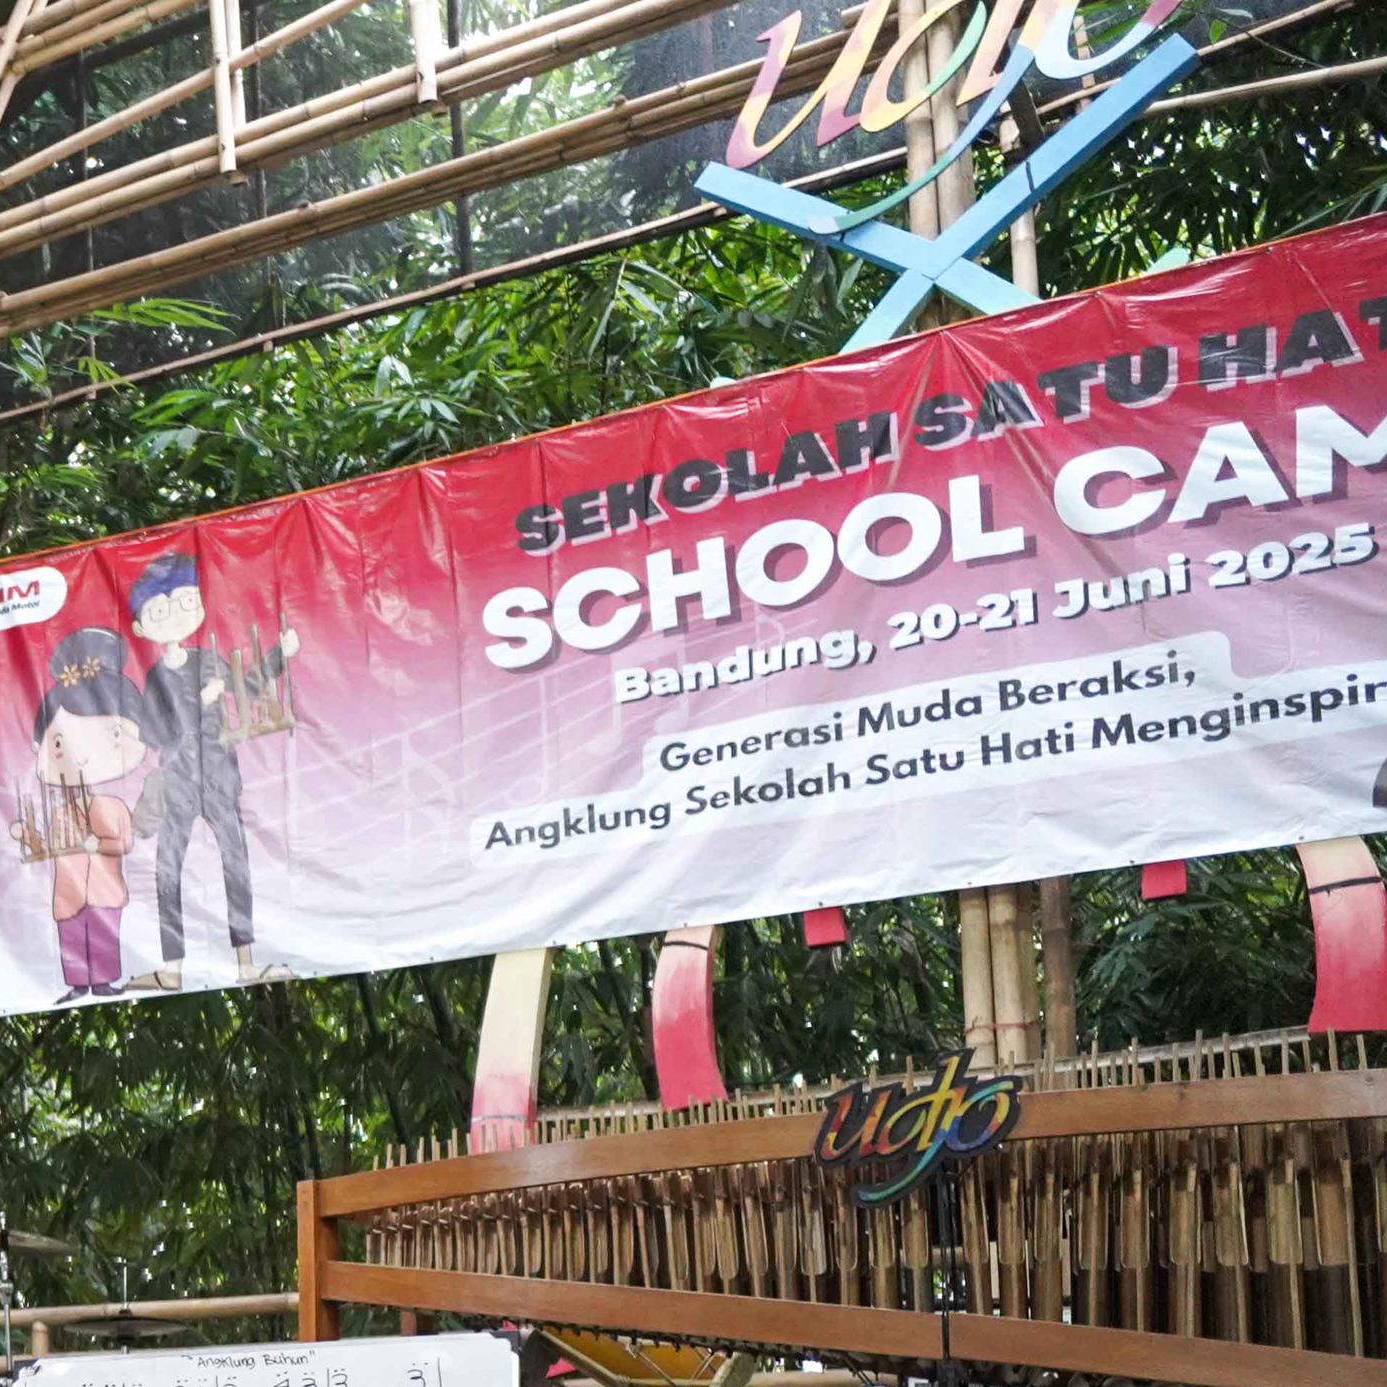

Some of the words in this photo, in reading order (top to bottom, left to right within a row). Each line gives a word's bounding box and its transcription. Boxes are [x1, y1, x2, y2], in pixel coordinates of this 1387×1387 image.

[515, 411, 898, 556] SEKOLAH
[914, 345, 1178, 451] SATU
[483, 474, 1026, 670] SCHOOL
[615, 628, 876, 703] Bandung,
[889, 588, 1037, 650] 20-21
[1053, 553, 1189, 620] Juni
[1207, 522, 1376, 588] 2025
[484, 800, 672, 850] Angklung
[685, 762, 851, 816] Sekolah
[865, 748, 965, 785] Satu
[981, 723, 1076, 766] Hati
[659, 711, 843, 771] Generasi
[857, 689, 983, 736] Muda
[998, 650, 1196, 712] Beraksi,
